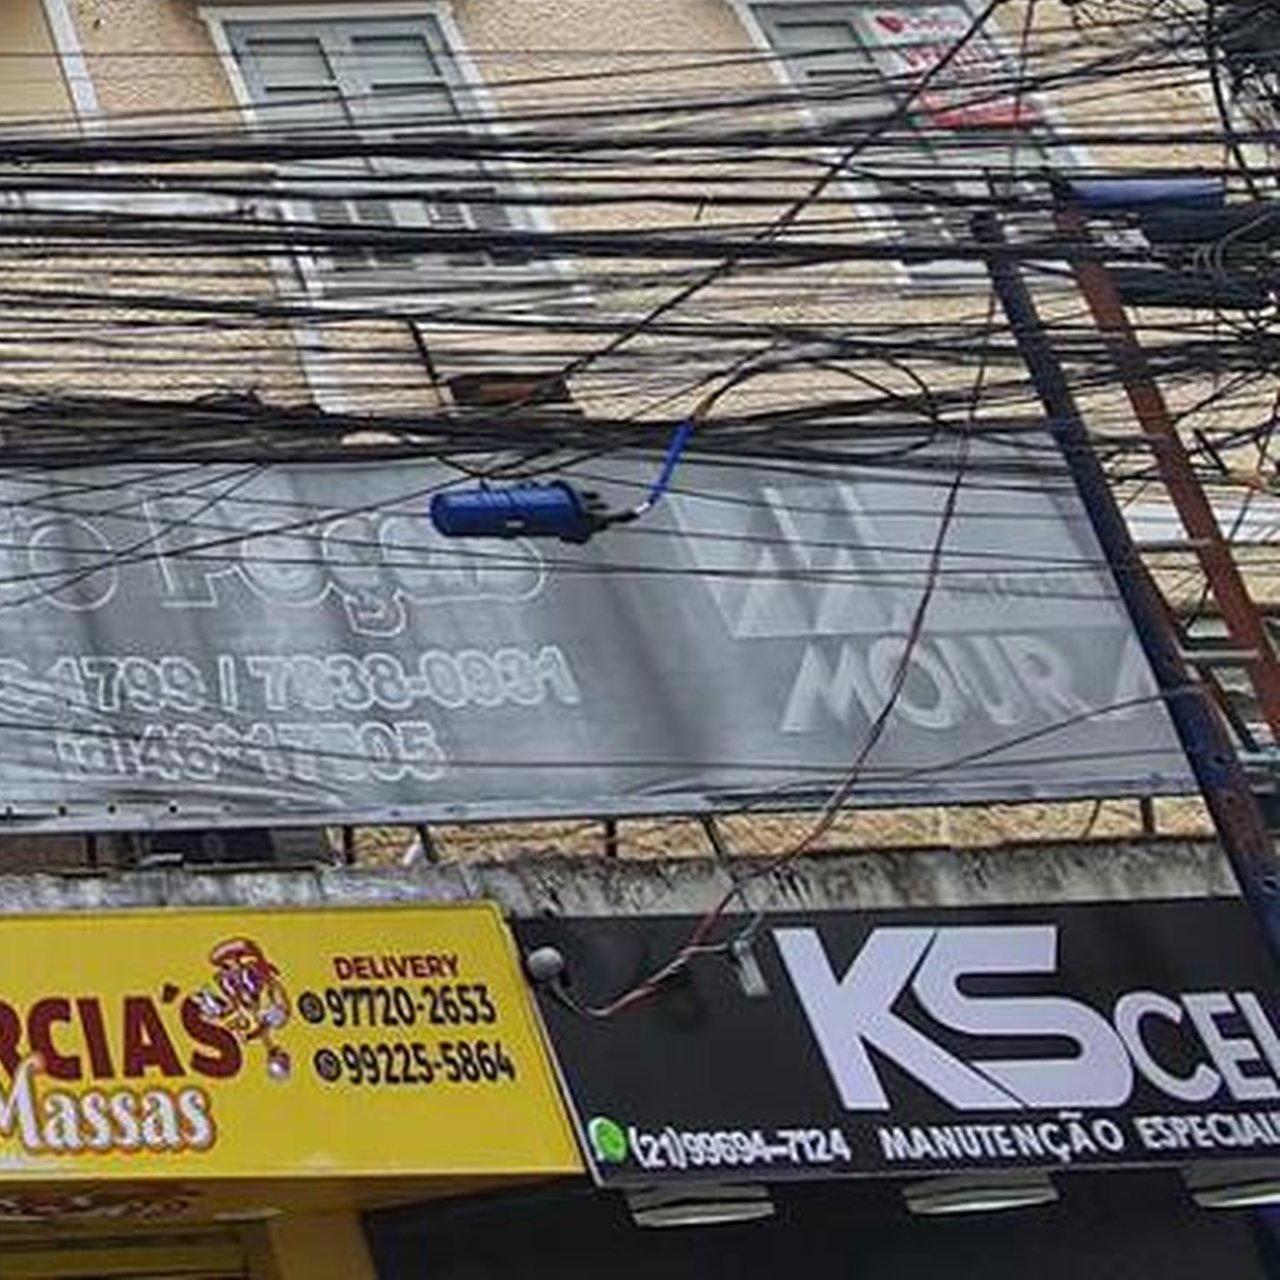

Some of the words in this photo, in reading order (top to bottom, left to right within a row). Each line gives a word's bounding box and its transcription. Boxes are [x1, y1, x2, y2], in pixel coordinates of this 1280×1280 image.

[333, 954, 459, 981] DELIVERY
[324, 983, 498, 1027] 97720-2653
[340, 1040, 517, 1085] 99225-5864
[877, 1111, 1124, 1162] MANUTENÇÃO
